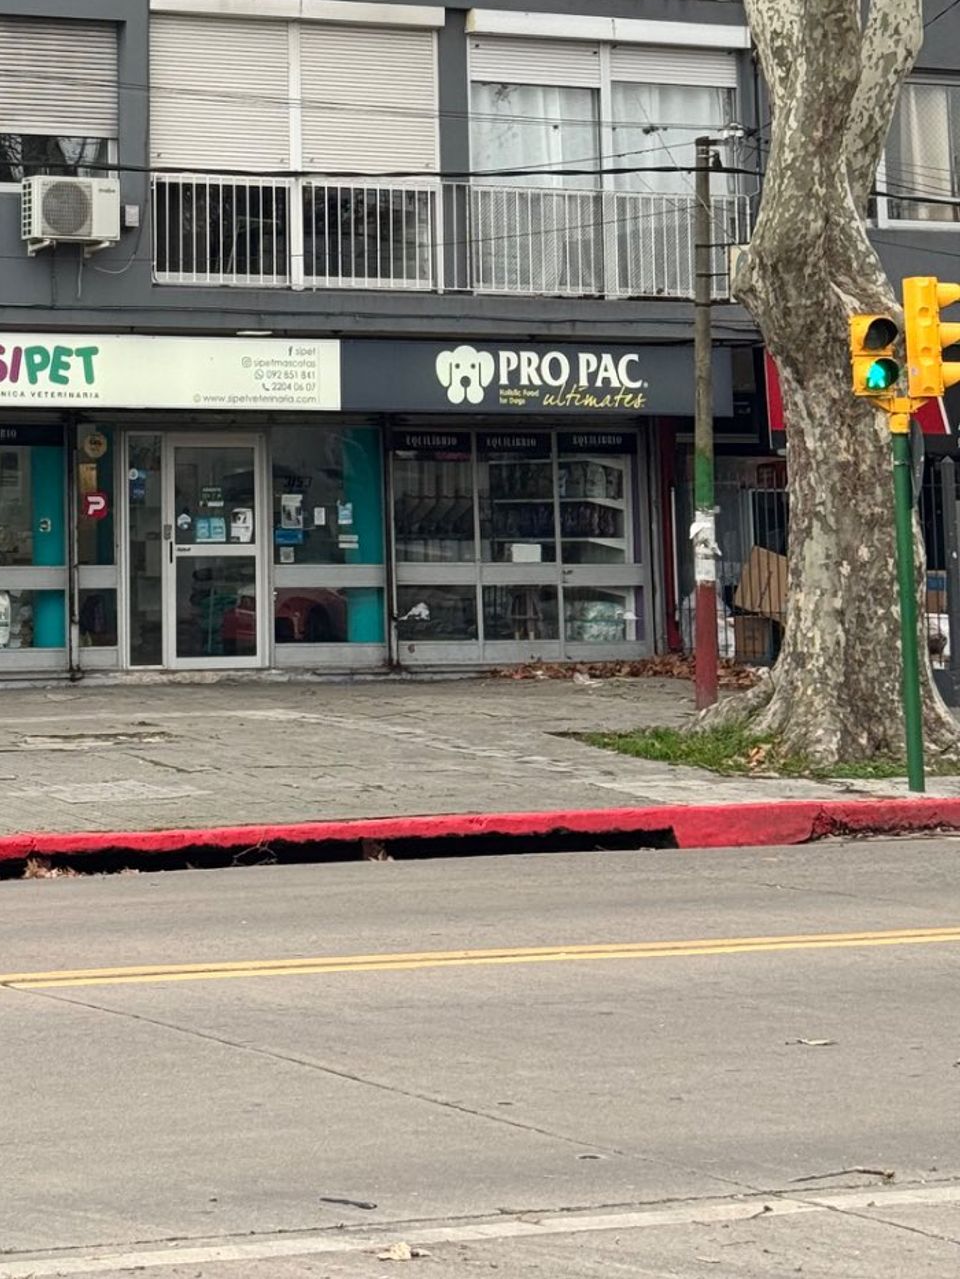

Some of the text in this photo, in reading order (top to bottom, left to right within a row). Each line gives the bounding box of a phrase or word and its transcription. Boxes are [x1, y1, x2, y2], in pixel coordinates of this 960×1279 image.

[295, 347, 316, 357] sipet
[253, 358, 316, 368] sipetmascotas
[498, 350, 570, 387] PRO
[30, 391, 100, 399] VETERINARIA
[543, 383, 645, 409] ultimates
